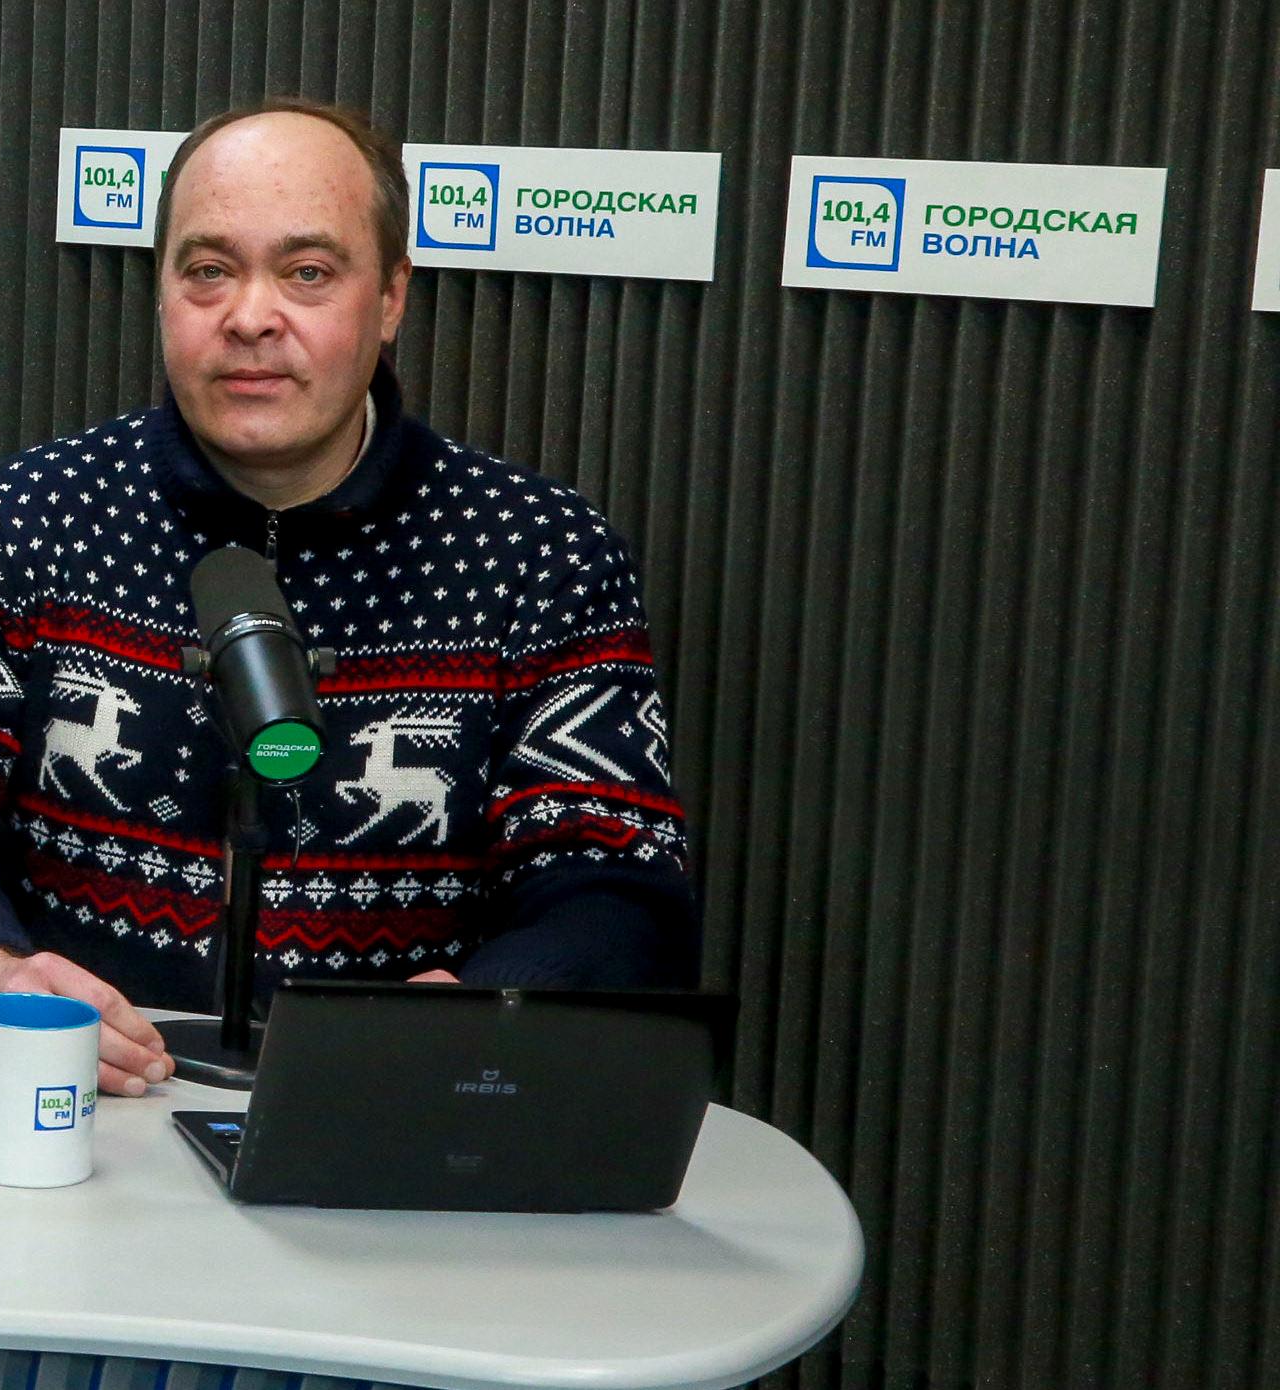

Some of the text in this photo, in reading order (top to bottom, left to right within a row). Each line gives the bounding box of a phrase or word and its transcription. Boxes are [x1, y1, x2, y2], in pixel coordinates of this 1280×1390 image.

[83, 166, 135, 189] 101,4
[105, 193, 133, 208] FM
[428, 184, 488, 209] 101,4
[515, 187, 698, 216] ГОРОДСКАЯ
[453, 212, 485, 229] FM
[822, 199, 891, 226] 101,4
[924, 203, 1138, 236] ГОРОДСКАЯ
[514, 215, 616, 239] ВОЛНА
[850, 230, 886, 248] FM
[922, 233, 1040, 260] ВОЛНА
[257, 743, 316, 752] ГОРОДСКАЯ
[454, 1083, 518, 1094] IRBIS
[41, 1097, 71, 1110] 101,4
[54, 1110, 70, 1120] FM
